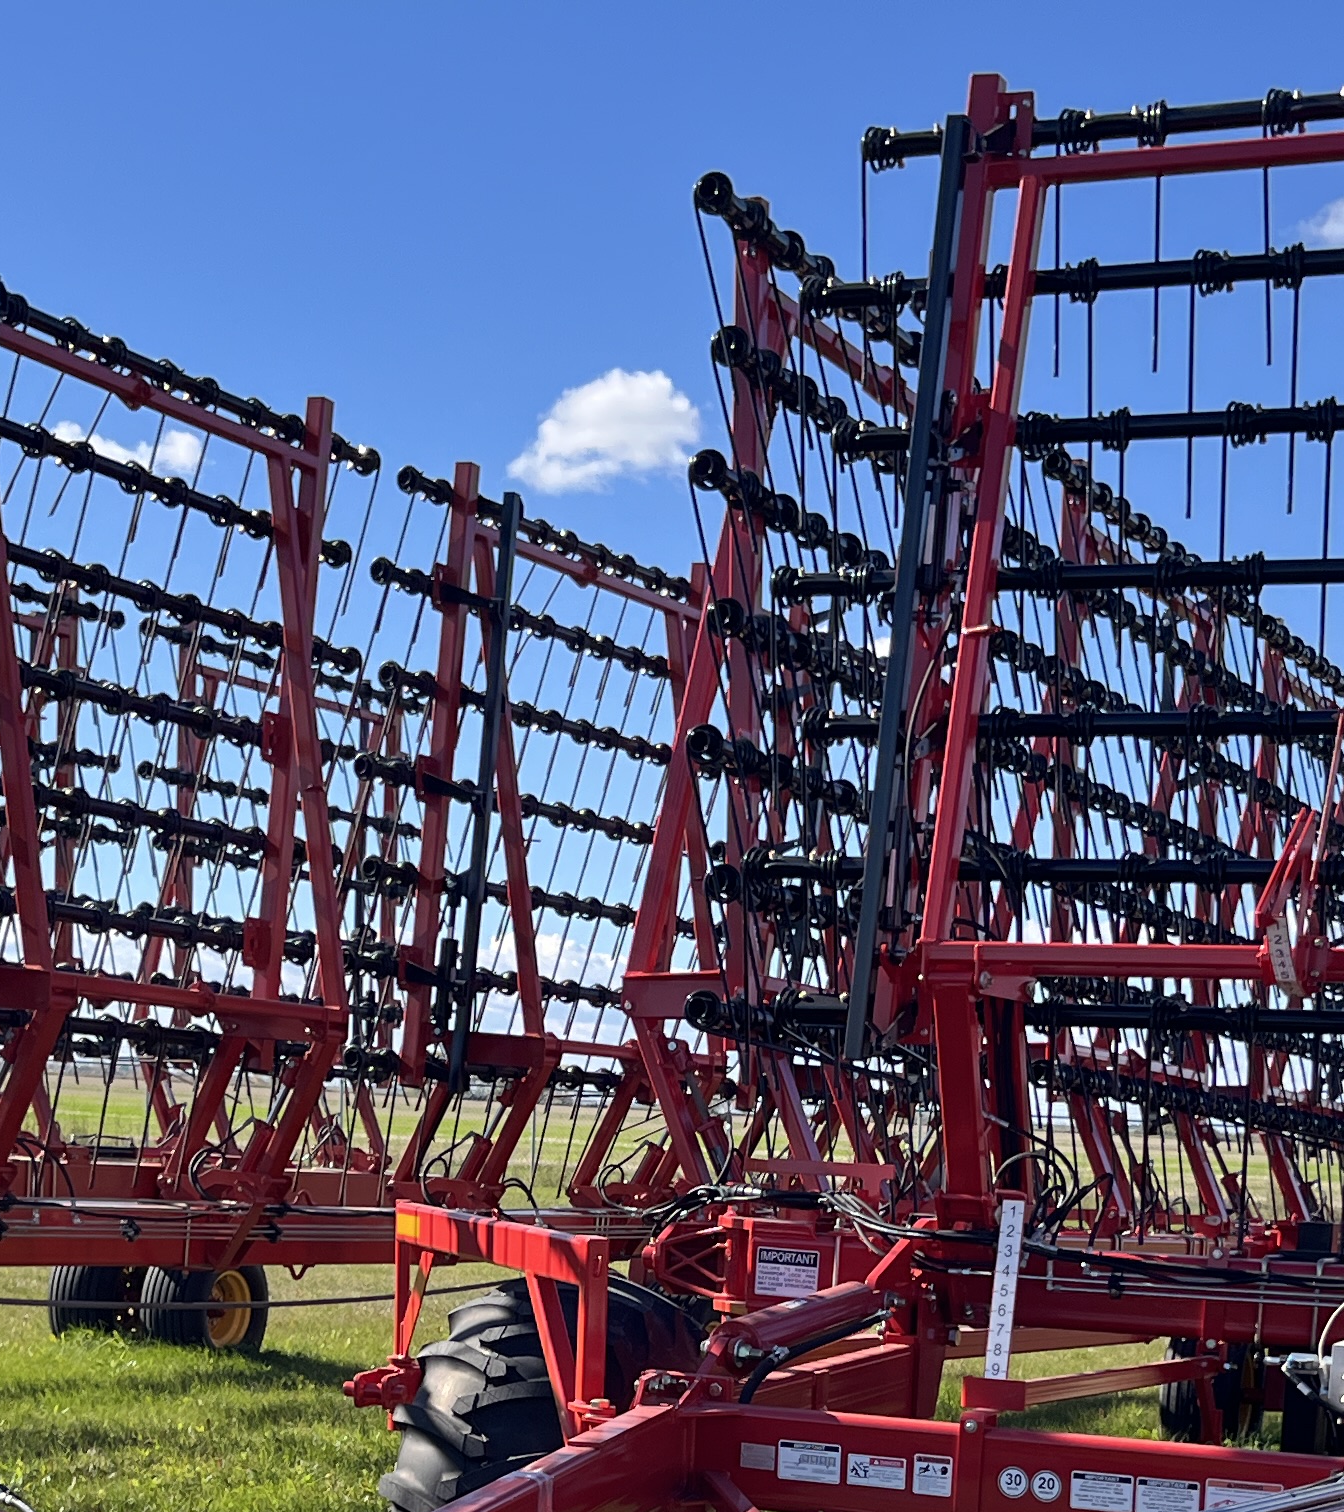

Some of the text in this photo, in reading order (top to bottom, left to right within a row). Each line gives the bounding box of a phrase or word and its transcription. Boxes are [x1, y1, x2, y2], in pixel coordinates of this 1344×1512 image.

[1011, 1206, 1016, 1218] 1
[1006, 1225, 1015, 1237] 2
[1004, 1245, 1012, 1257] 3
[761, 1251, 815, 1264] IMPORTANT
[1002, 1265, 1009, 1277] 4
[1000, 1284, 1008, 1297] 5
[998, 1304, 1006, 1316] 6
[996, 1324, 1004, 1336] 7
[994, 1344, 1001, 1356] 8
[992, 1363, 999, 1375] 9
[1005, 1473, 1022, 1486] 30
[1038, 1477, 1055, 1490] 20
